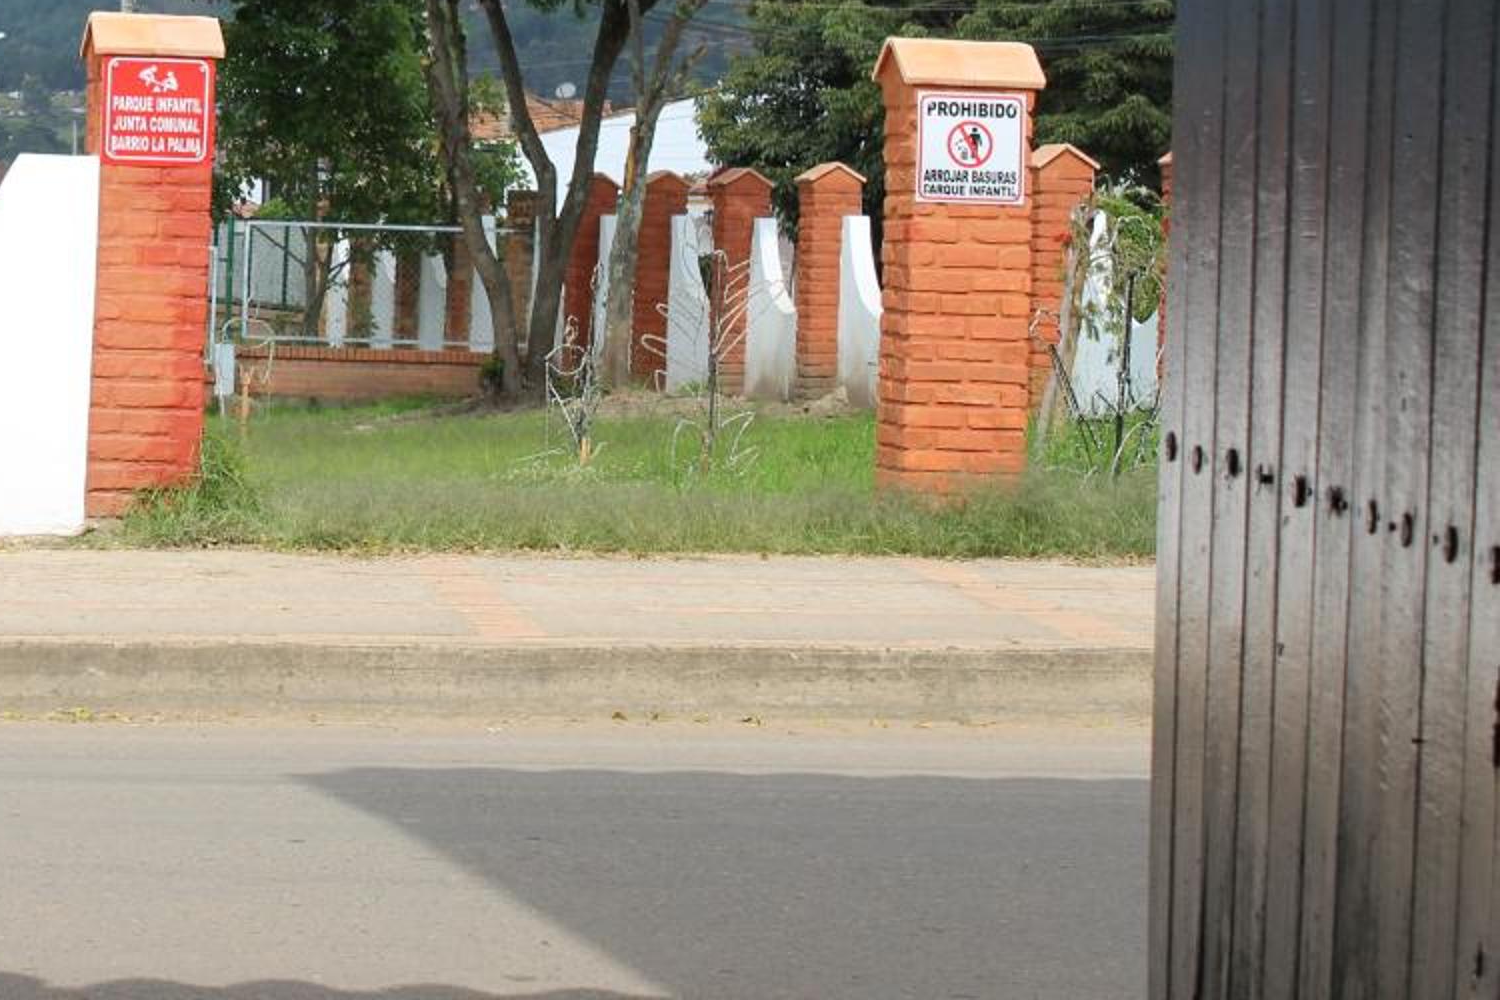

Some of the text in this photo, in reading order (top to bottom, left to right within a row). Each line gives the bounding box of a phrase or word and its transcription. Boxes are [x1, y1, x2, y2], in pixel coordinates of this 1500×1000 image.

[112, 95, 202, 115] PARQUE INFANTIL
[927, 101, 1017, 119] PROHIBIDO
[113, 115, 201, 134] JUNTA COMUNAL
[111, 135, 200, 154] BARRIO LA PALMA
[923, 170, 1017, 185] ARROJAR BASURAS
[969, 185, 1016, 197] INFANTIL
